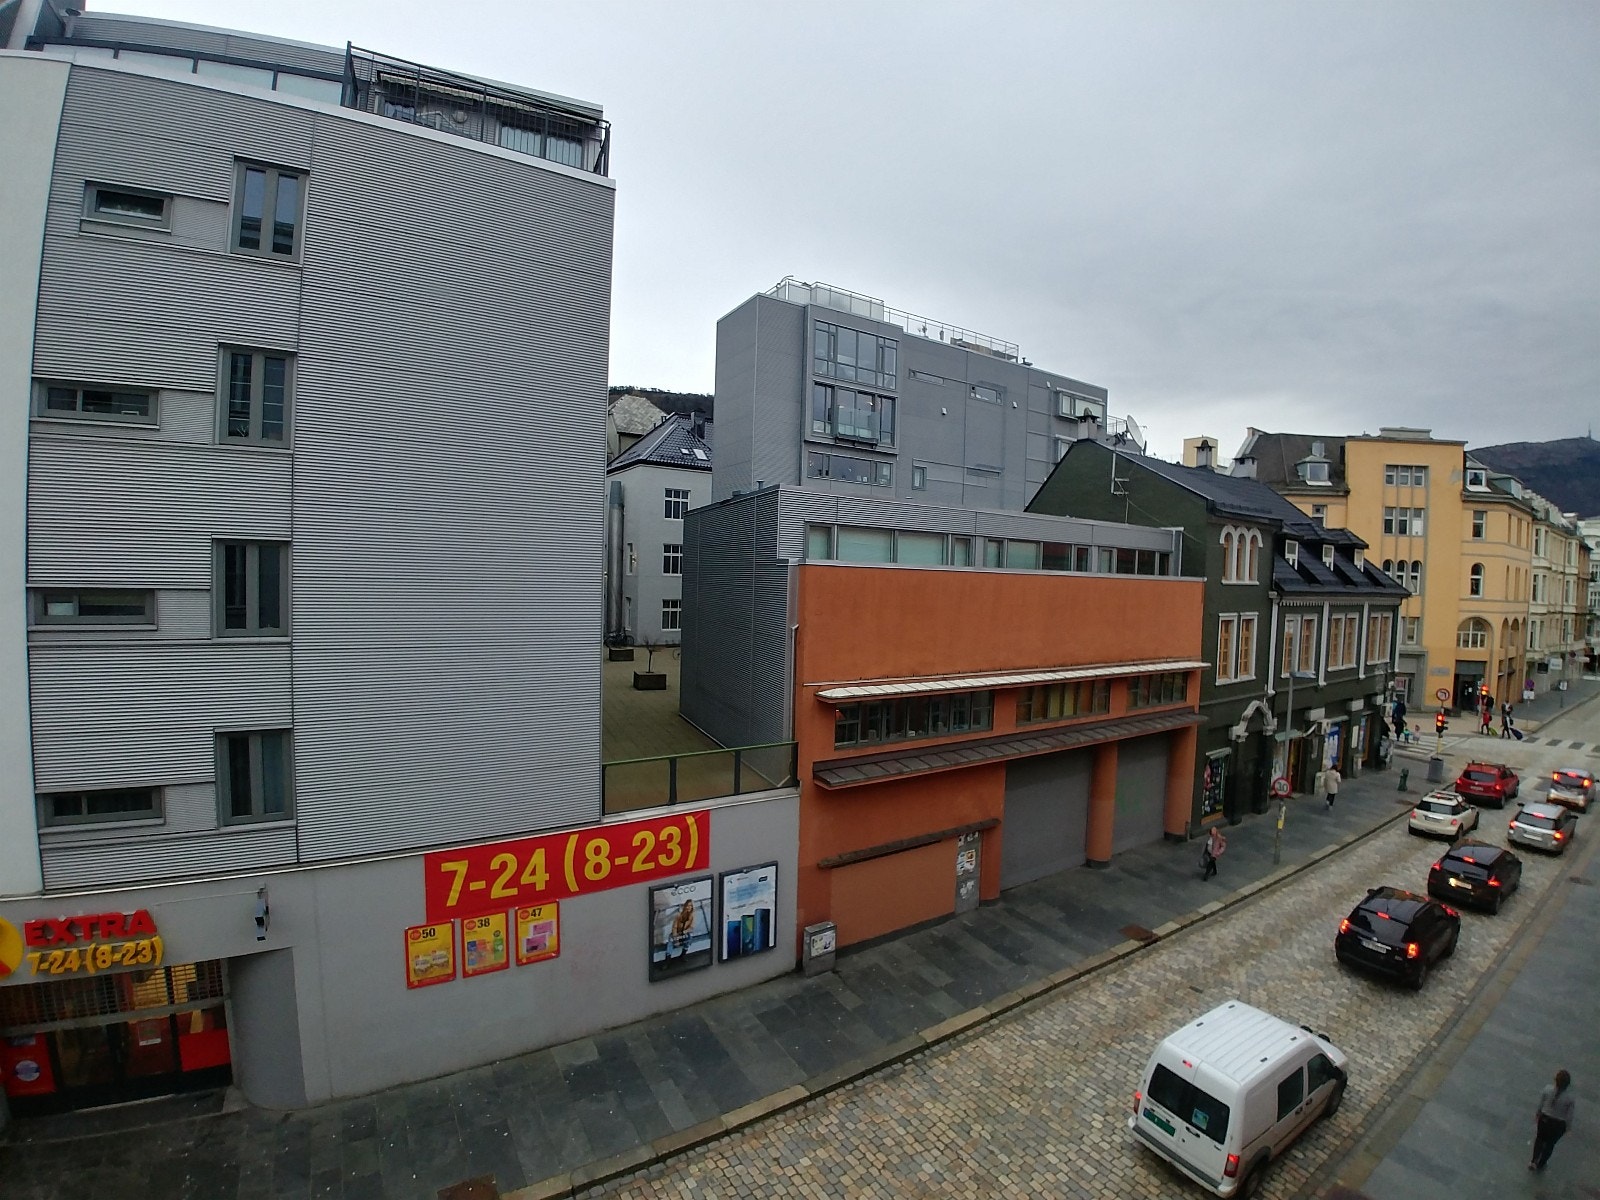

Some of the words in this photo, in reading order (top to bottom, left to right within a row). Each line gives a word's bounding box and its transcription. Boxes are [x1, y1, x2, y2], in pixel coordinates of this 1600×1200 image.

[1276, 781, 1288, 793] 30
[440, 847, 550, 907] 7-24
[563, 815, 700, 893] (8-23)
[530, 907, 543, 918] 47
[24, 909, 158, 947] EXTRA
[476, 917, 491, 928] 38
[421, 927, 436, 939] 50
